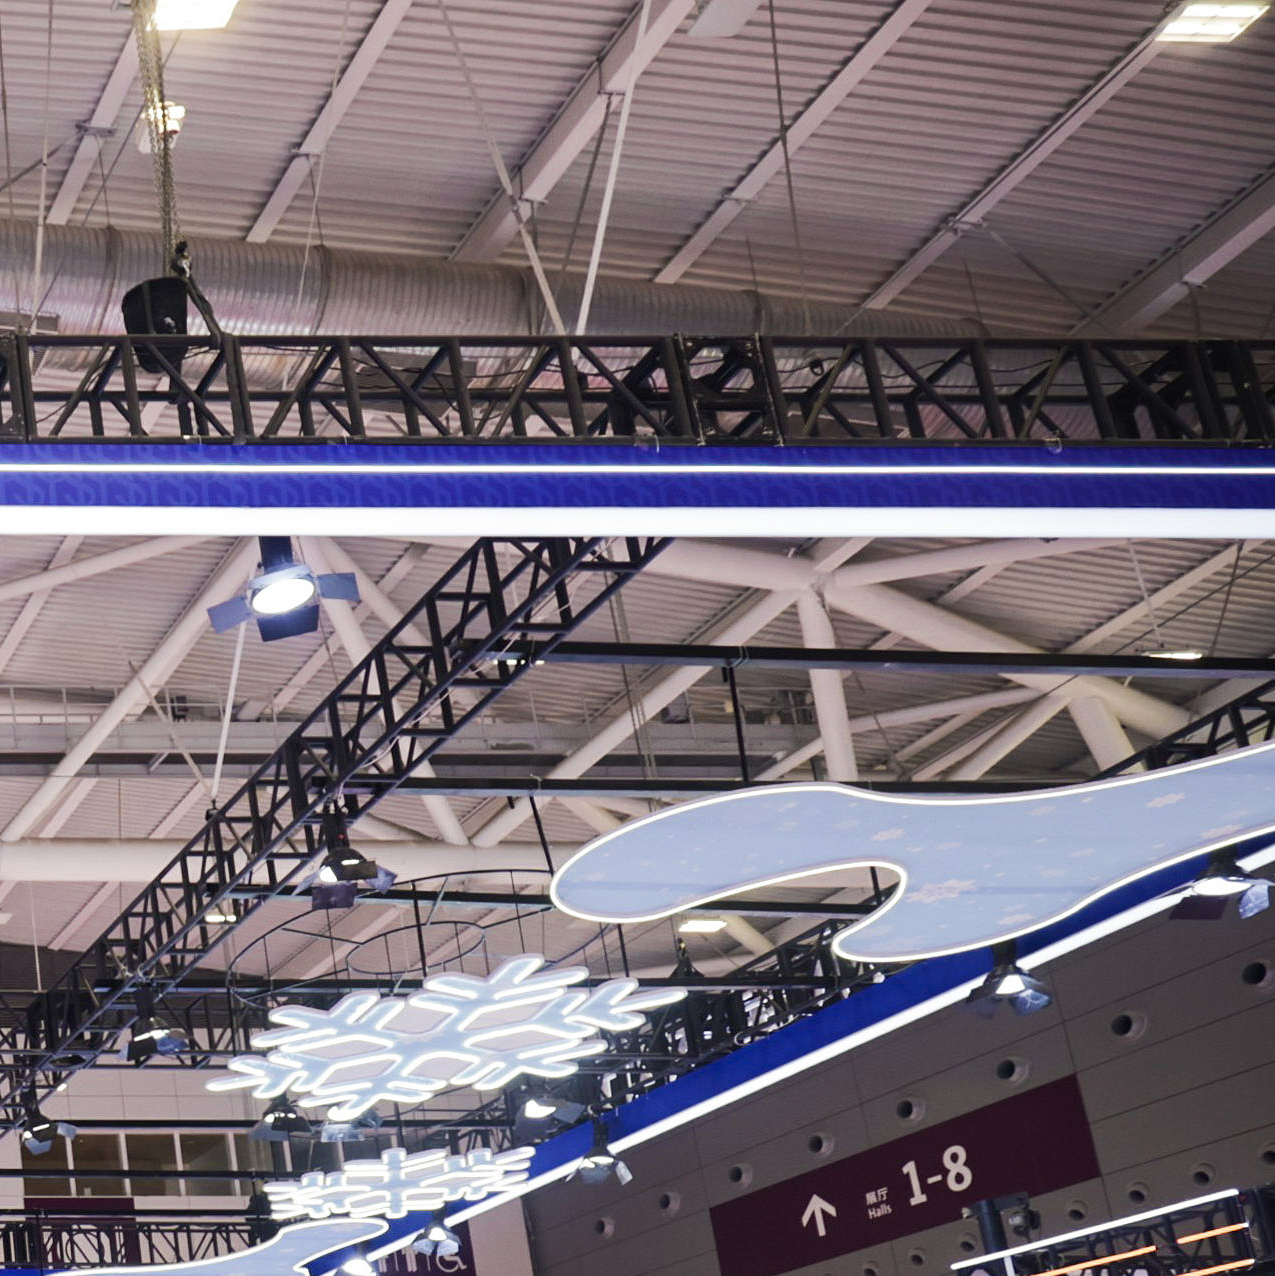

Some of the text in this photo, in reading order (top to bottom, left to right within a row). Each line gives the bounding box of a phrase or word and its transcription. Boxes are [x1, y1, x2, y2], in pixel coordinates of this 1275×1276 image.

[902, 1145, 972, 1206] 1-8
[866, 1187, 888, 1205] 展厅
[868, 1204, 892, 1219] Halls
